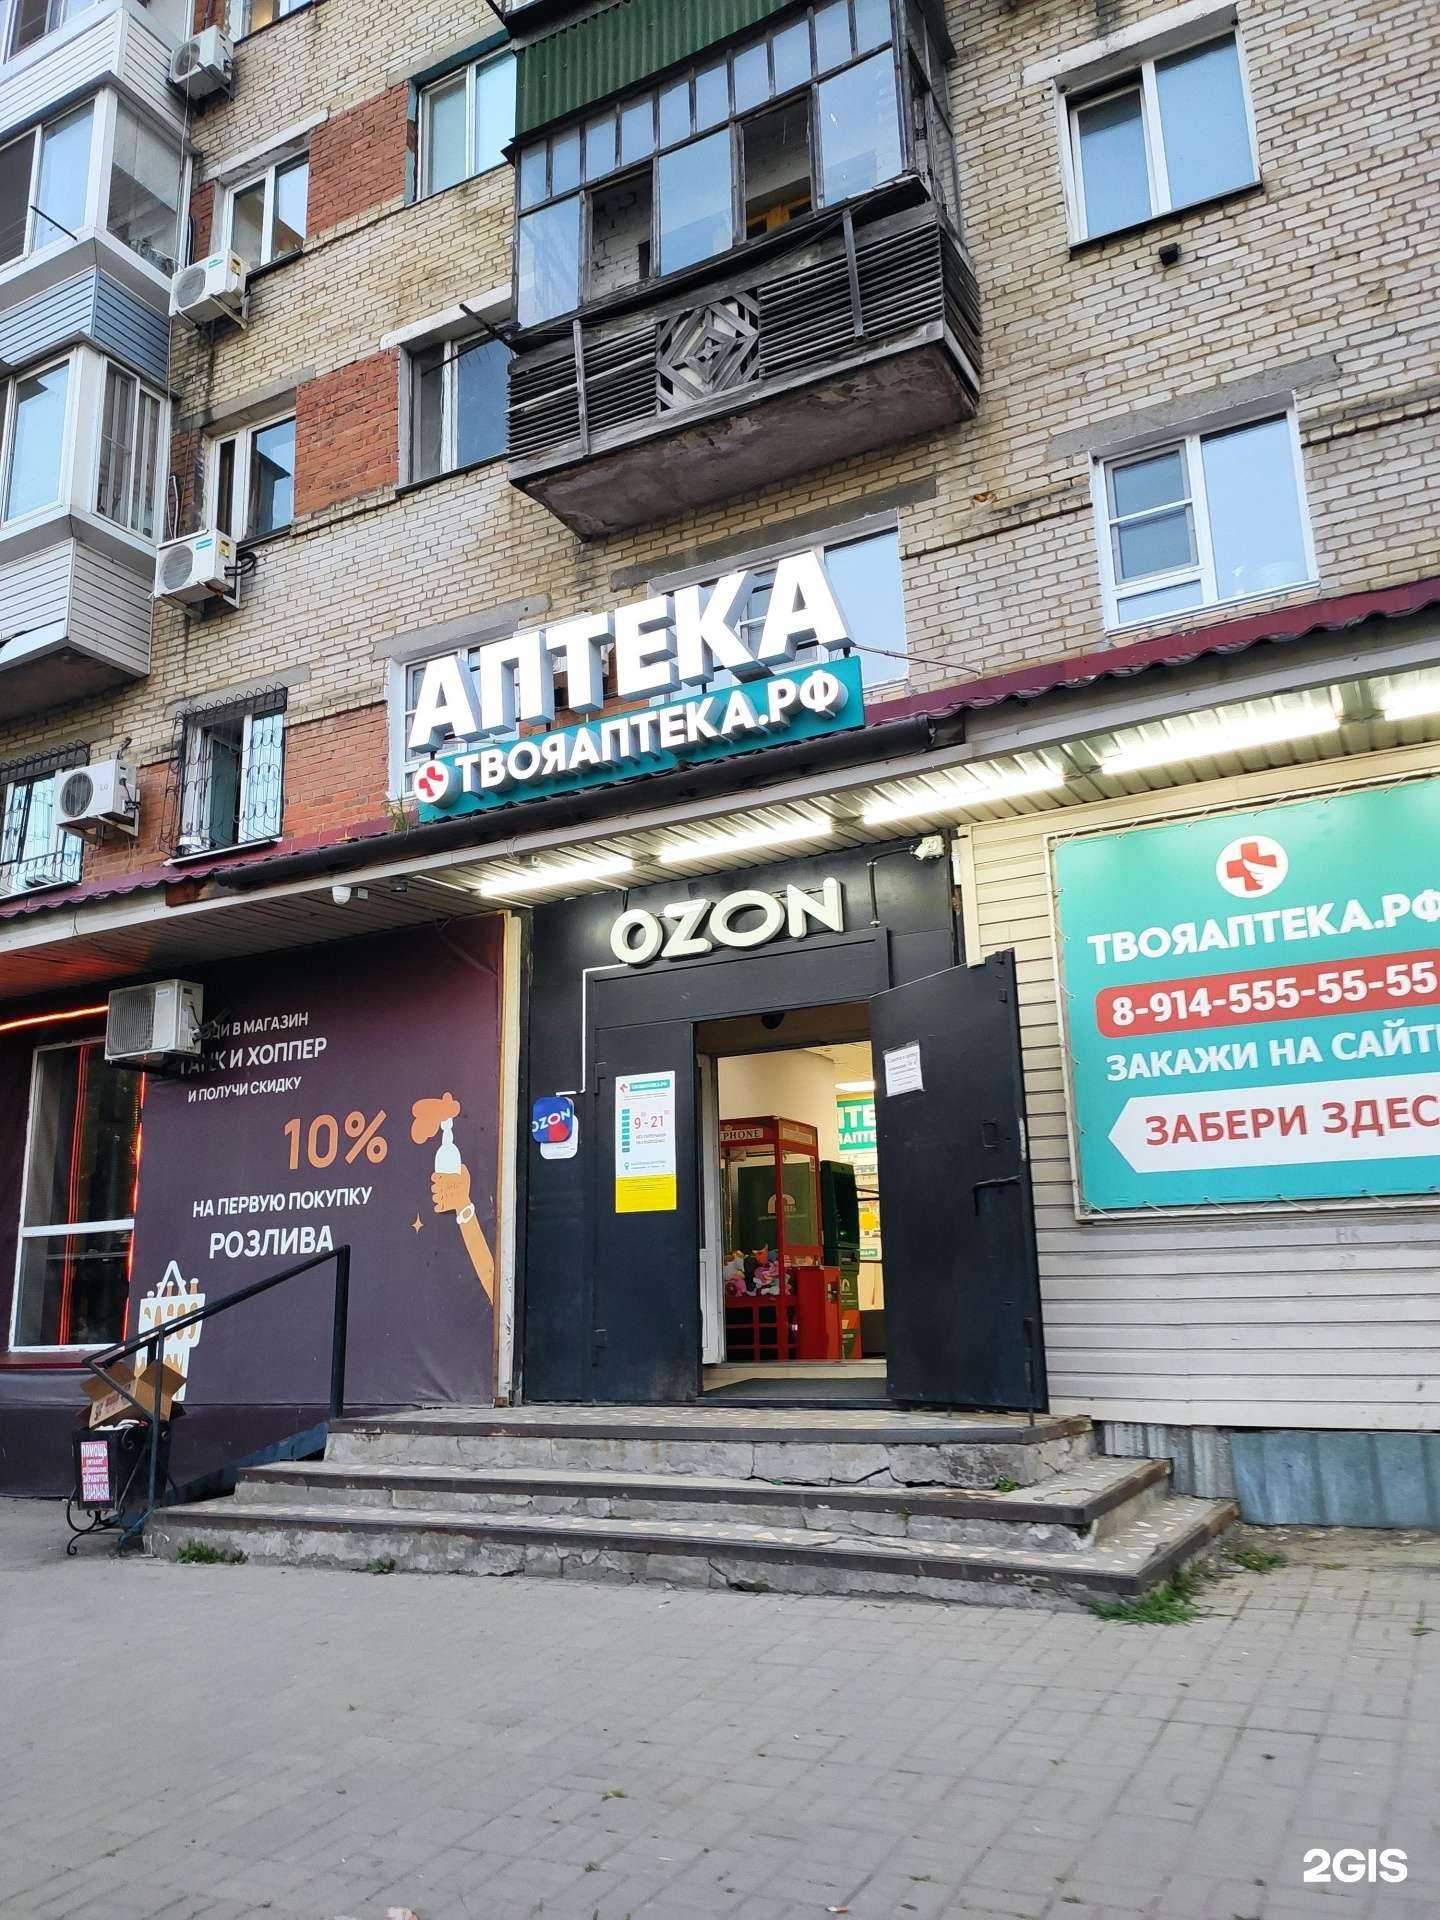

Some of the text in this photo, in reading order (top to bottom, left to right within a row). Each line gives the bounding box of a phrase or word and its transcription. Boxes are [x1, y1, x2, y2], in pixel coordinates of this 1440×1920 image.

[408, 551, 853, 751] АПТЕКА
[455, 669, 846, 793] ТВОЯАПТЕКА.РФ
[610, 877, 843, 964] OZON
[1087, 888, 1440, 965] ТВОЯАПТЕКА.РФ
[1111, 961, 1438, 1027] 8-914-555-55-55
[232, 1021, 241, 1036] В
[243, 1011, 309, 1034] МАГАЗИН
[229, 1047, 243, 1069] И
[246, 1037, 328, 1067] ХОППЕР
[1106, 1019, 1440, 1082] ЗАКАЖИ НА САЙТ
[188, 1076, 302, 1103] И ПОЛУЧИ СКИДКУ
[284, 1110, 388, 1170] 10%
[720, 1129, 761, 1141] PHONE
[1145, 1105, 1307, 1147] ЗАБЕРИ
[192, 1186, 373, 1218] НА ПЕРВУЮ ПОКУПКУ
[208, 1225, 334, 1259] РОЗЛИВА
